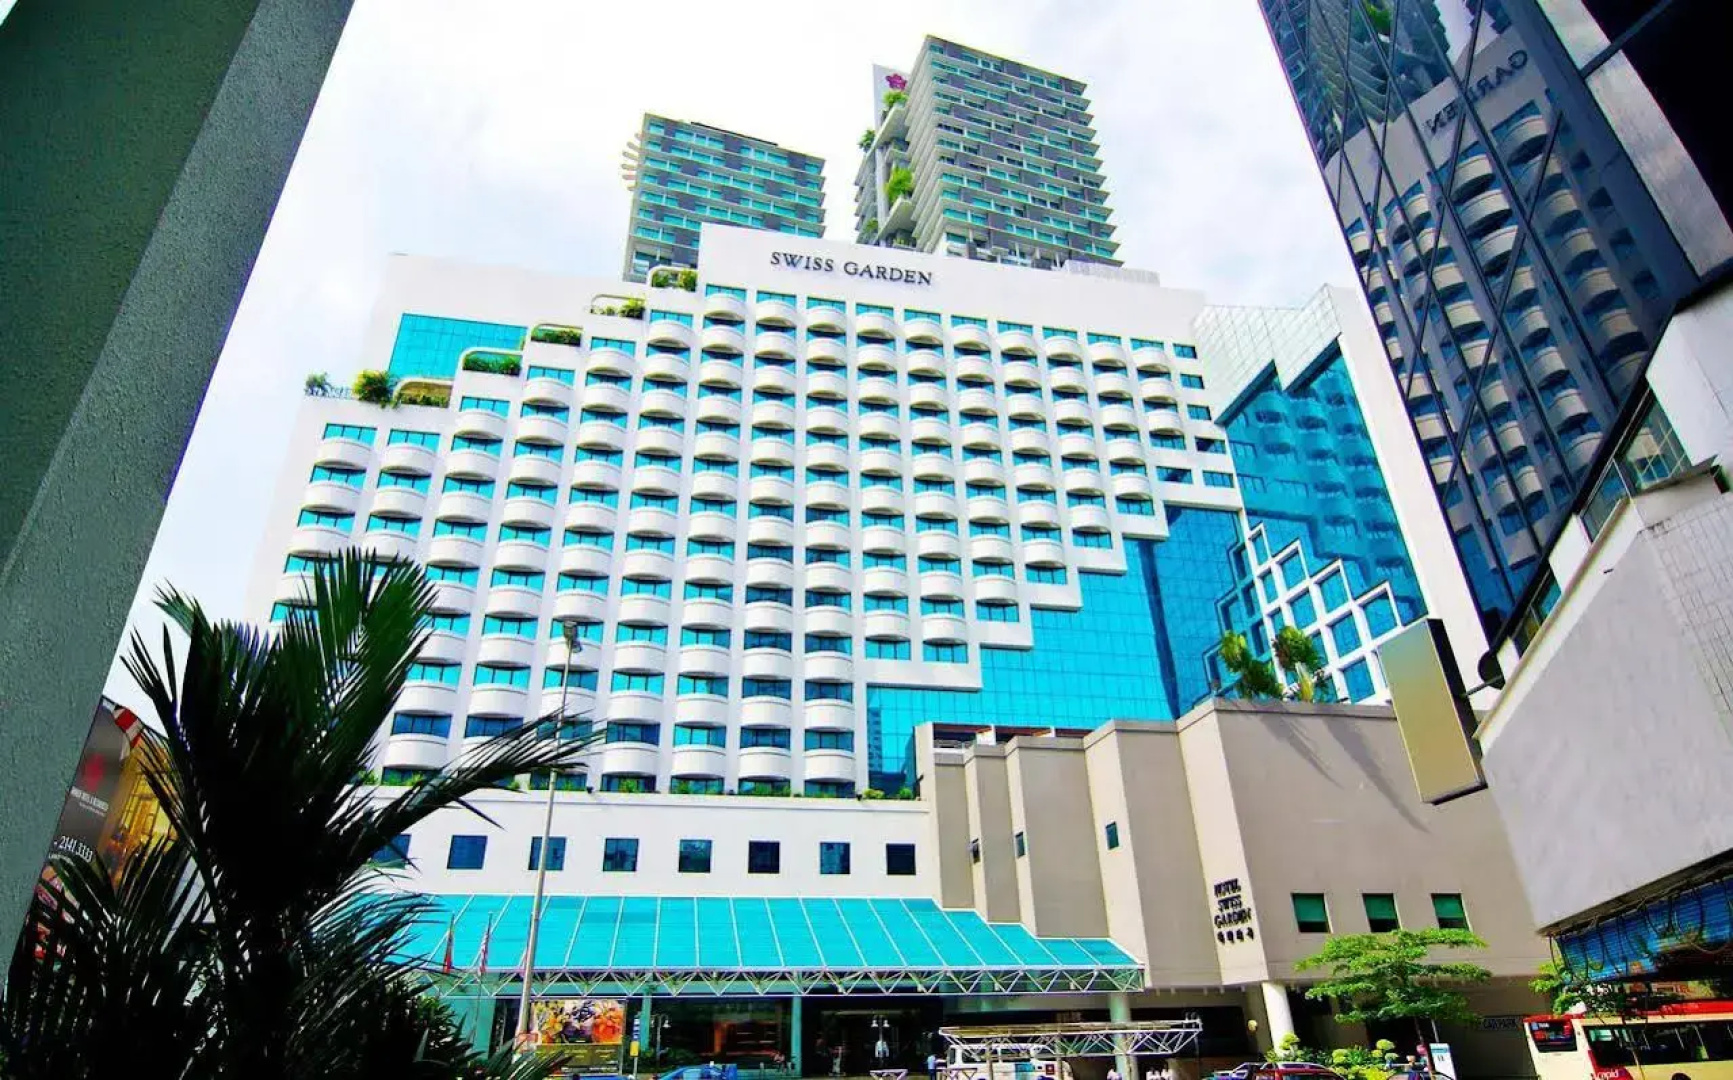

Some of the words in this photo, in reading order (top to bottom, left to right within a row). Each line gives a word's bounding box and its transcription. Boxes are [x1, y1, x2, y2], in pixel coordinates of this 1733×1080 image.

[770, 251, 834, 272] SWISS
[843, 261, 932, 286] GARDEN
[59, 836, 77, 853] 2141
[1214, 908, 1252, 928] GARDEN
